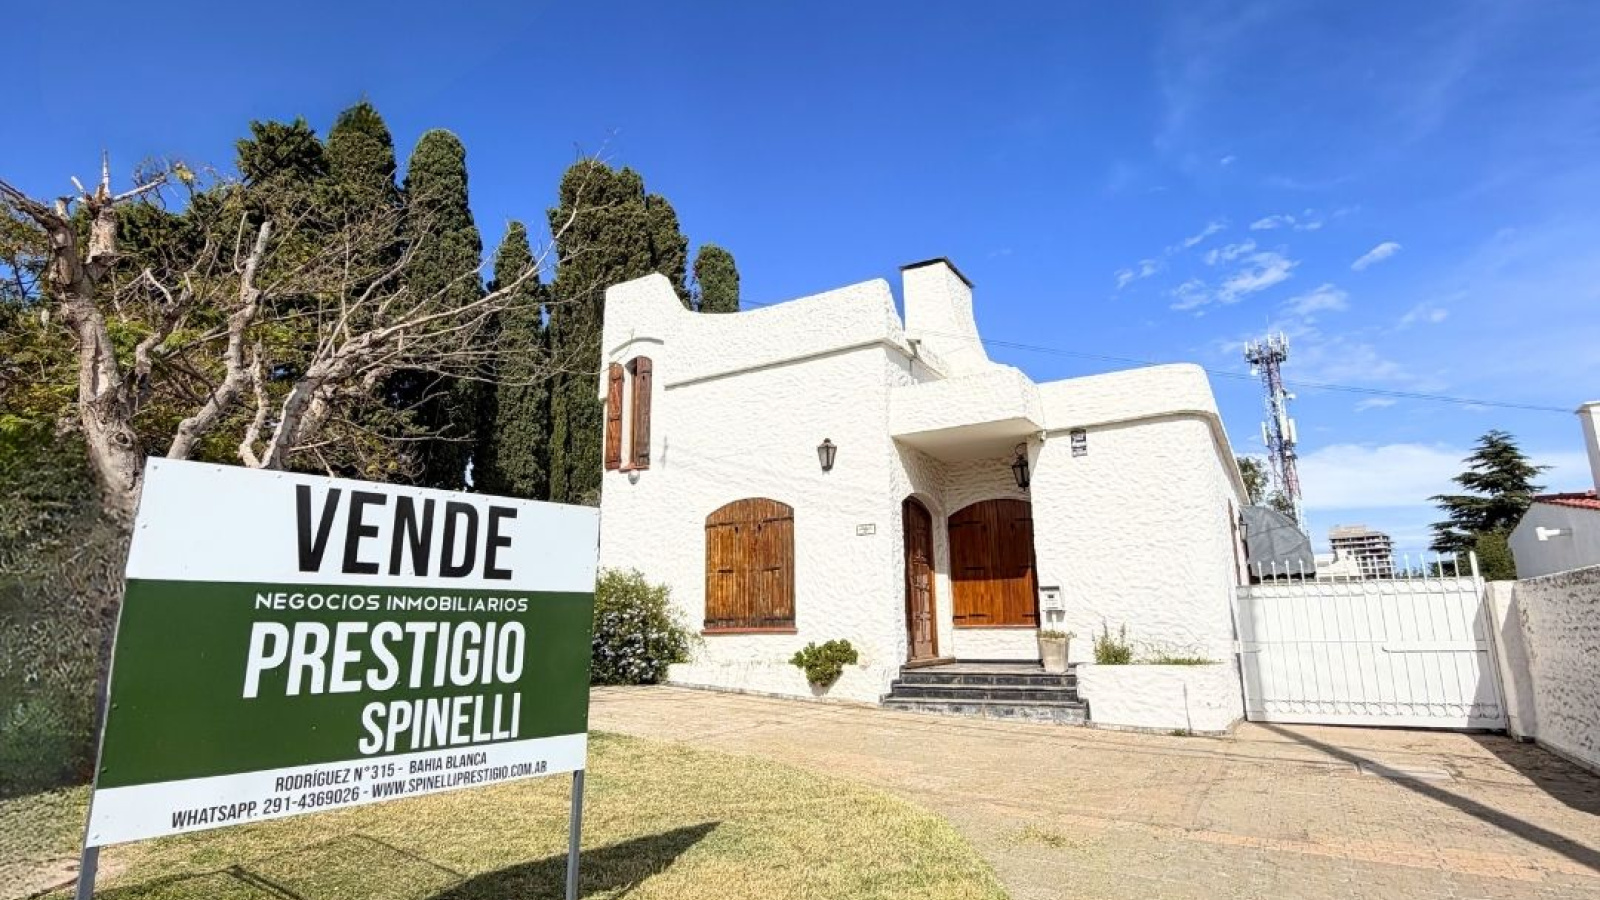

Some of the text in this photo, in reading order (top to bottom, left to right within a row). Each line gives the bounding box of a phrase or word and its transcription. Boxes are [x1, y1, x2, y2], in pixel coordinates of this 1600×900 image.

[296, 484, 517, 580] VENDE
[255, 593, 529, 612] NEGOCIOS INMOBILIARIOS
[243, 621, 526, 698] PRESTIGIO
[358, 692, 521, 754] SPINELLI
[171, 801, 258, 829] WHATSAPP.
[263, 786, 360, 815] 291-4369026
[372, 760, 548, 798] WWW.SPINELLIPRESTIGIO.COM.AR
[275, 769, 350, 793] RODRÍGUEZ
[409, 757, 443, 774] BAHIA
[445, 751, 487, 769] BLANCA
